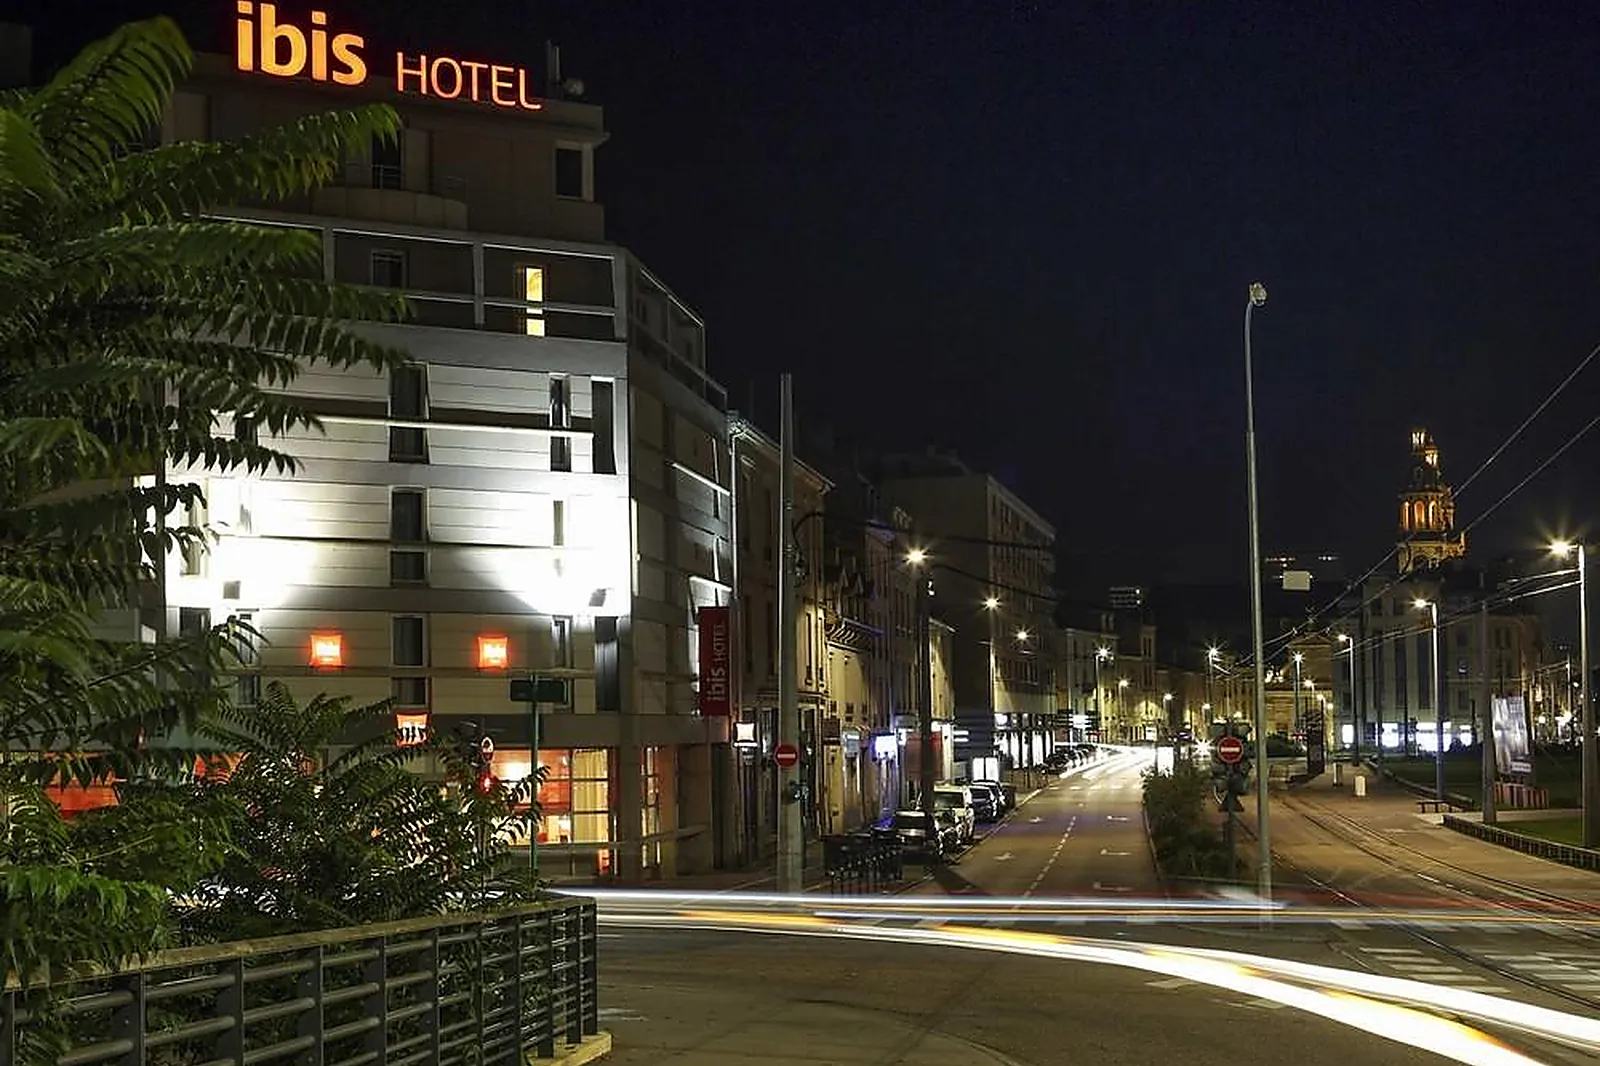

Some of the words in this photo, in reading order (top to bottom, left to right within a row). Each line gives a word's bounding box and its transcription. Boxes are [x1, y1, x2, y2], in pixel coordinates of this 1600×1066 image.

[237, 1, 367, 85] ibis
[397, 52, 542, 109] HOTEL
[713, 621, 727, 662] HOTEL
[706, 667, 727, 701] ibis
